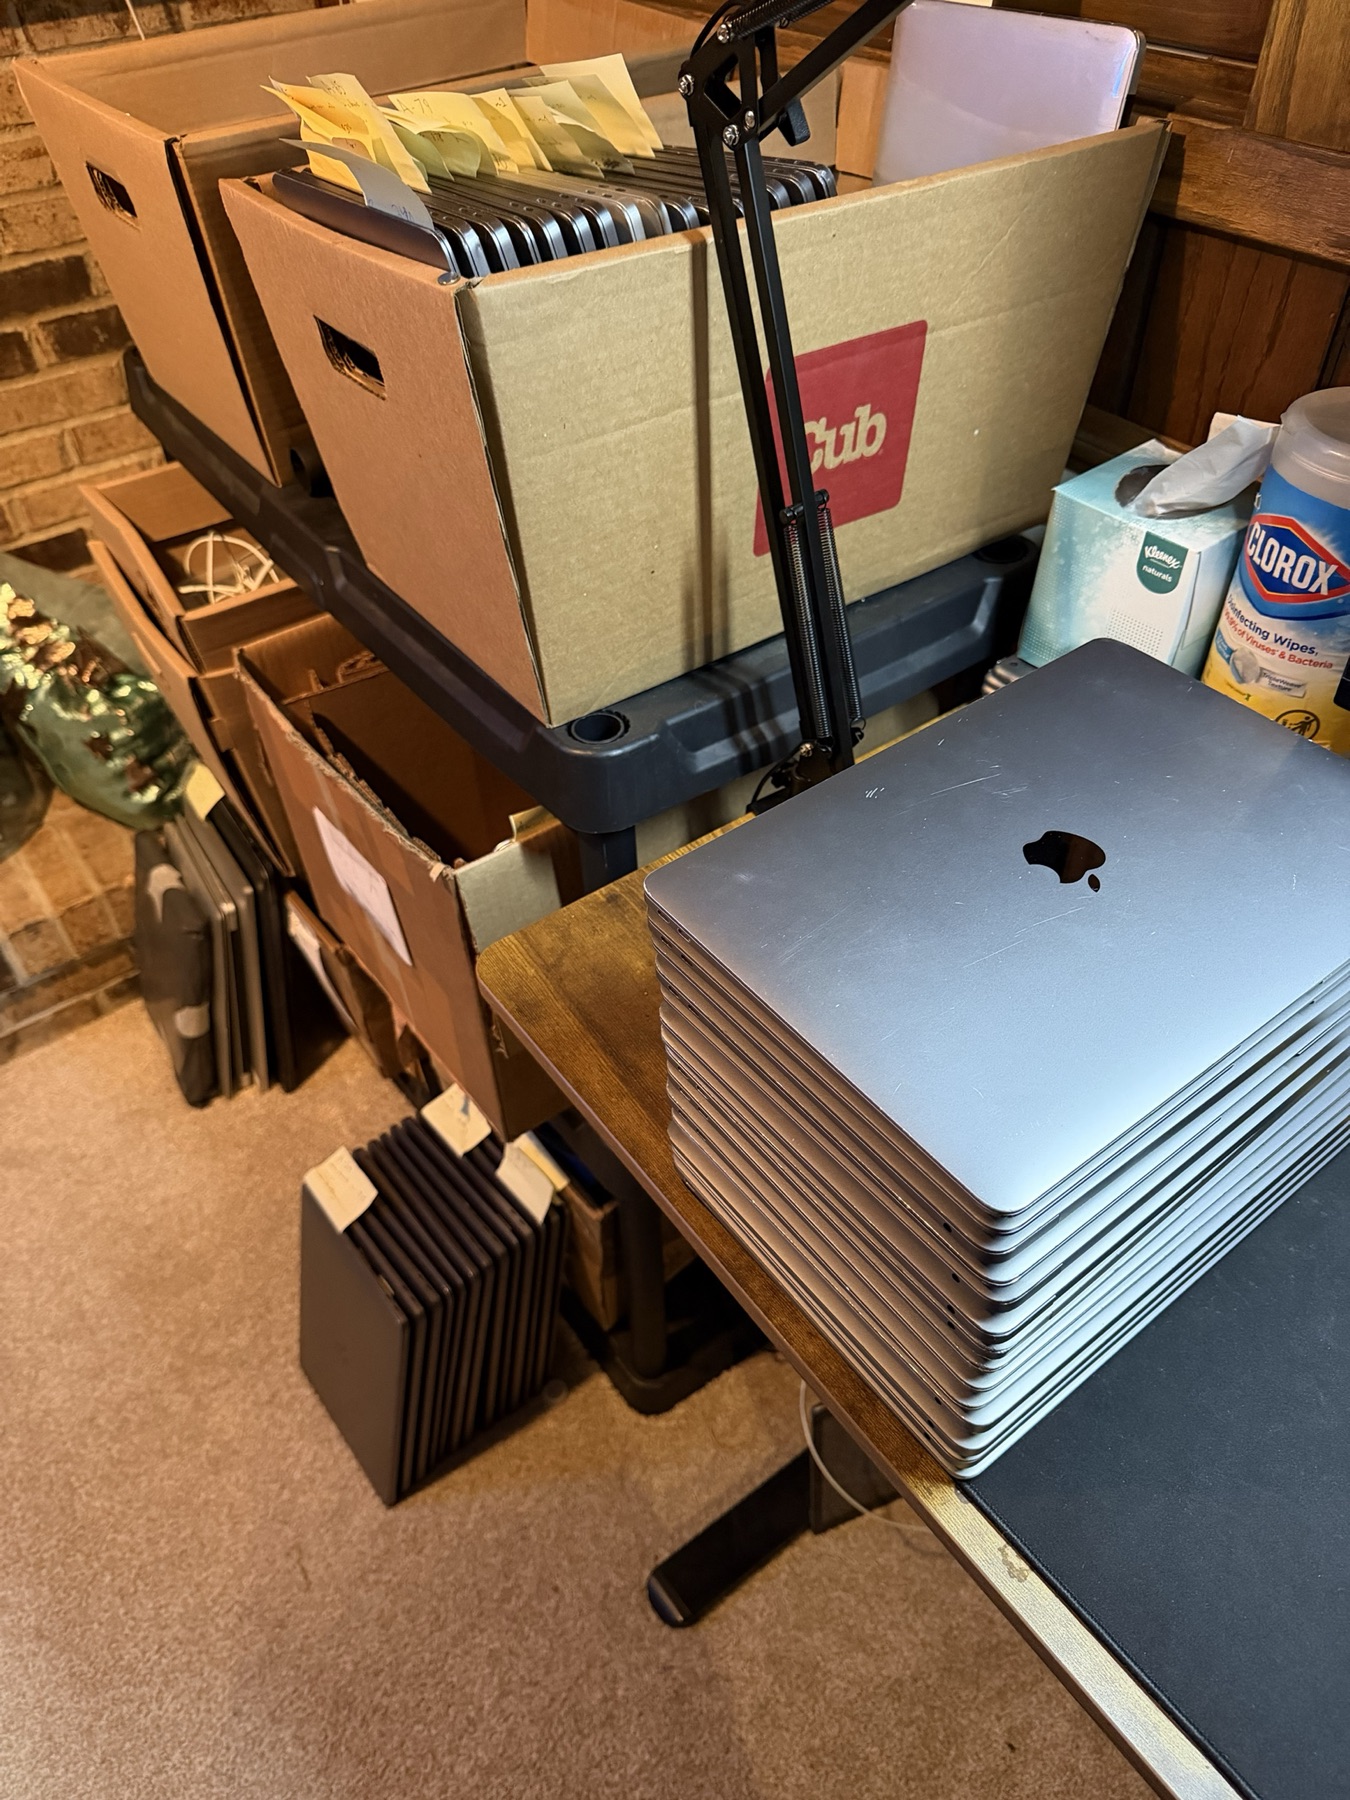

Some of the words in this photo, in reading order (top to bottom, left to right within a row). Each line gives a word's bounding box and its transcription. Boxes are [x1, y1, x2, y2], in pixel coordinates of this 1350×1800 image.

[1144, 545, 1181, 570] Kleenex
[1246, 520, 1339, 596] CLOROX
[1142, 565, 1172, 582] naturals
[1273, 633, 1319, 657] Wipes,
[1278, 650, 1286, 660] &
[1287, 653, 1334, 669] Bacteria
